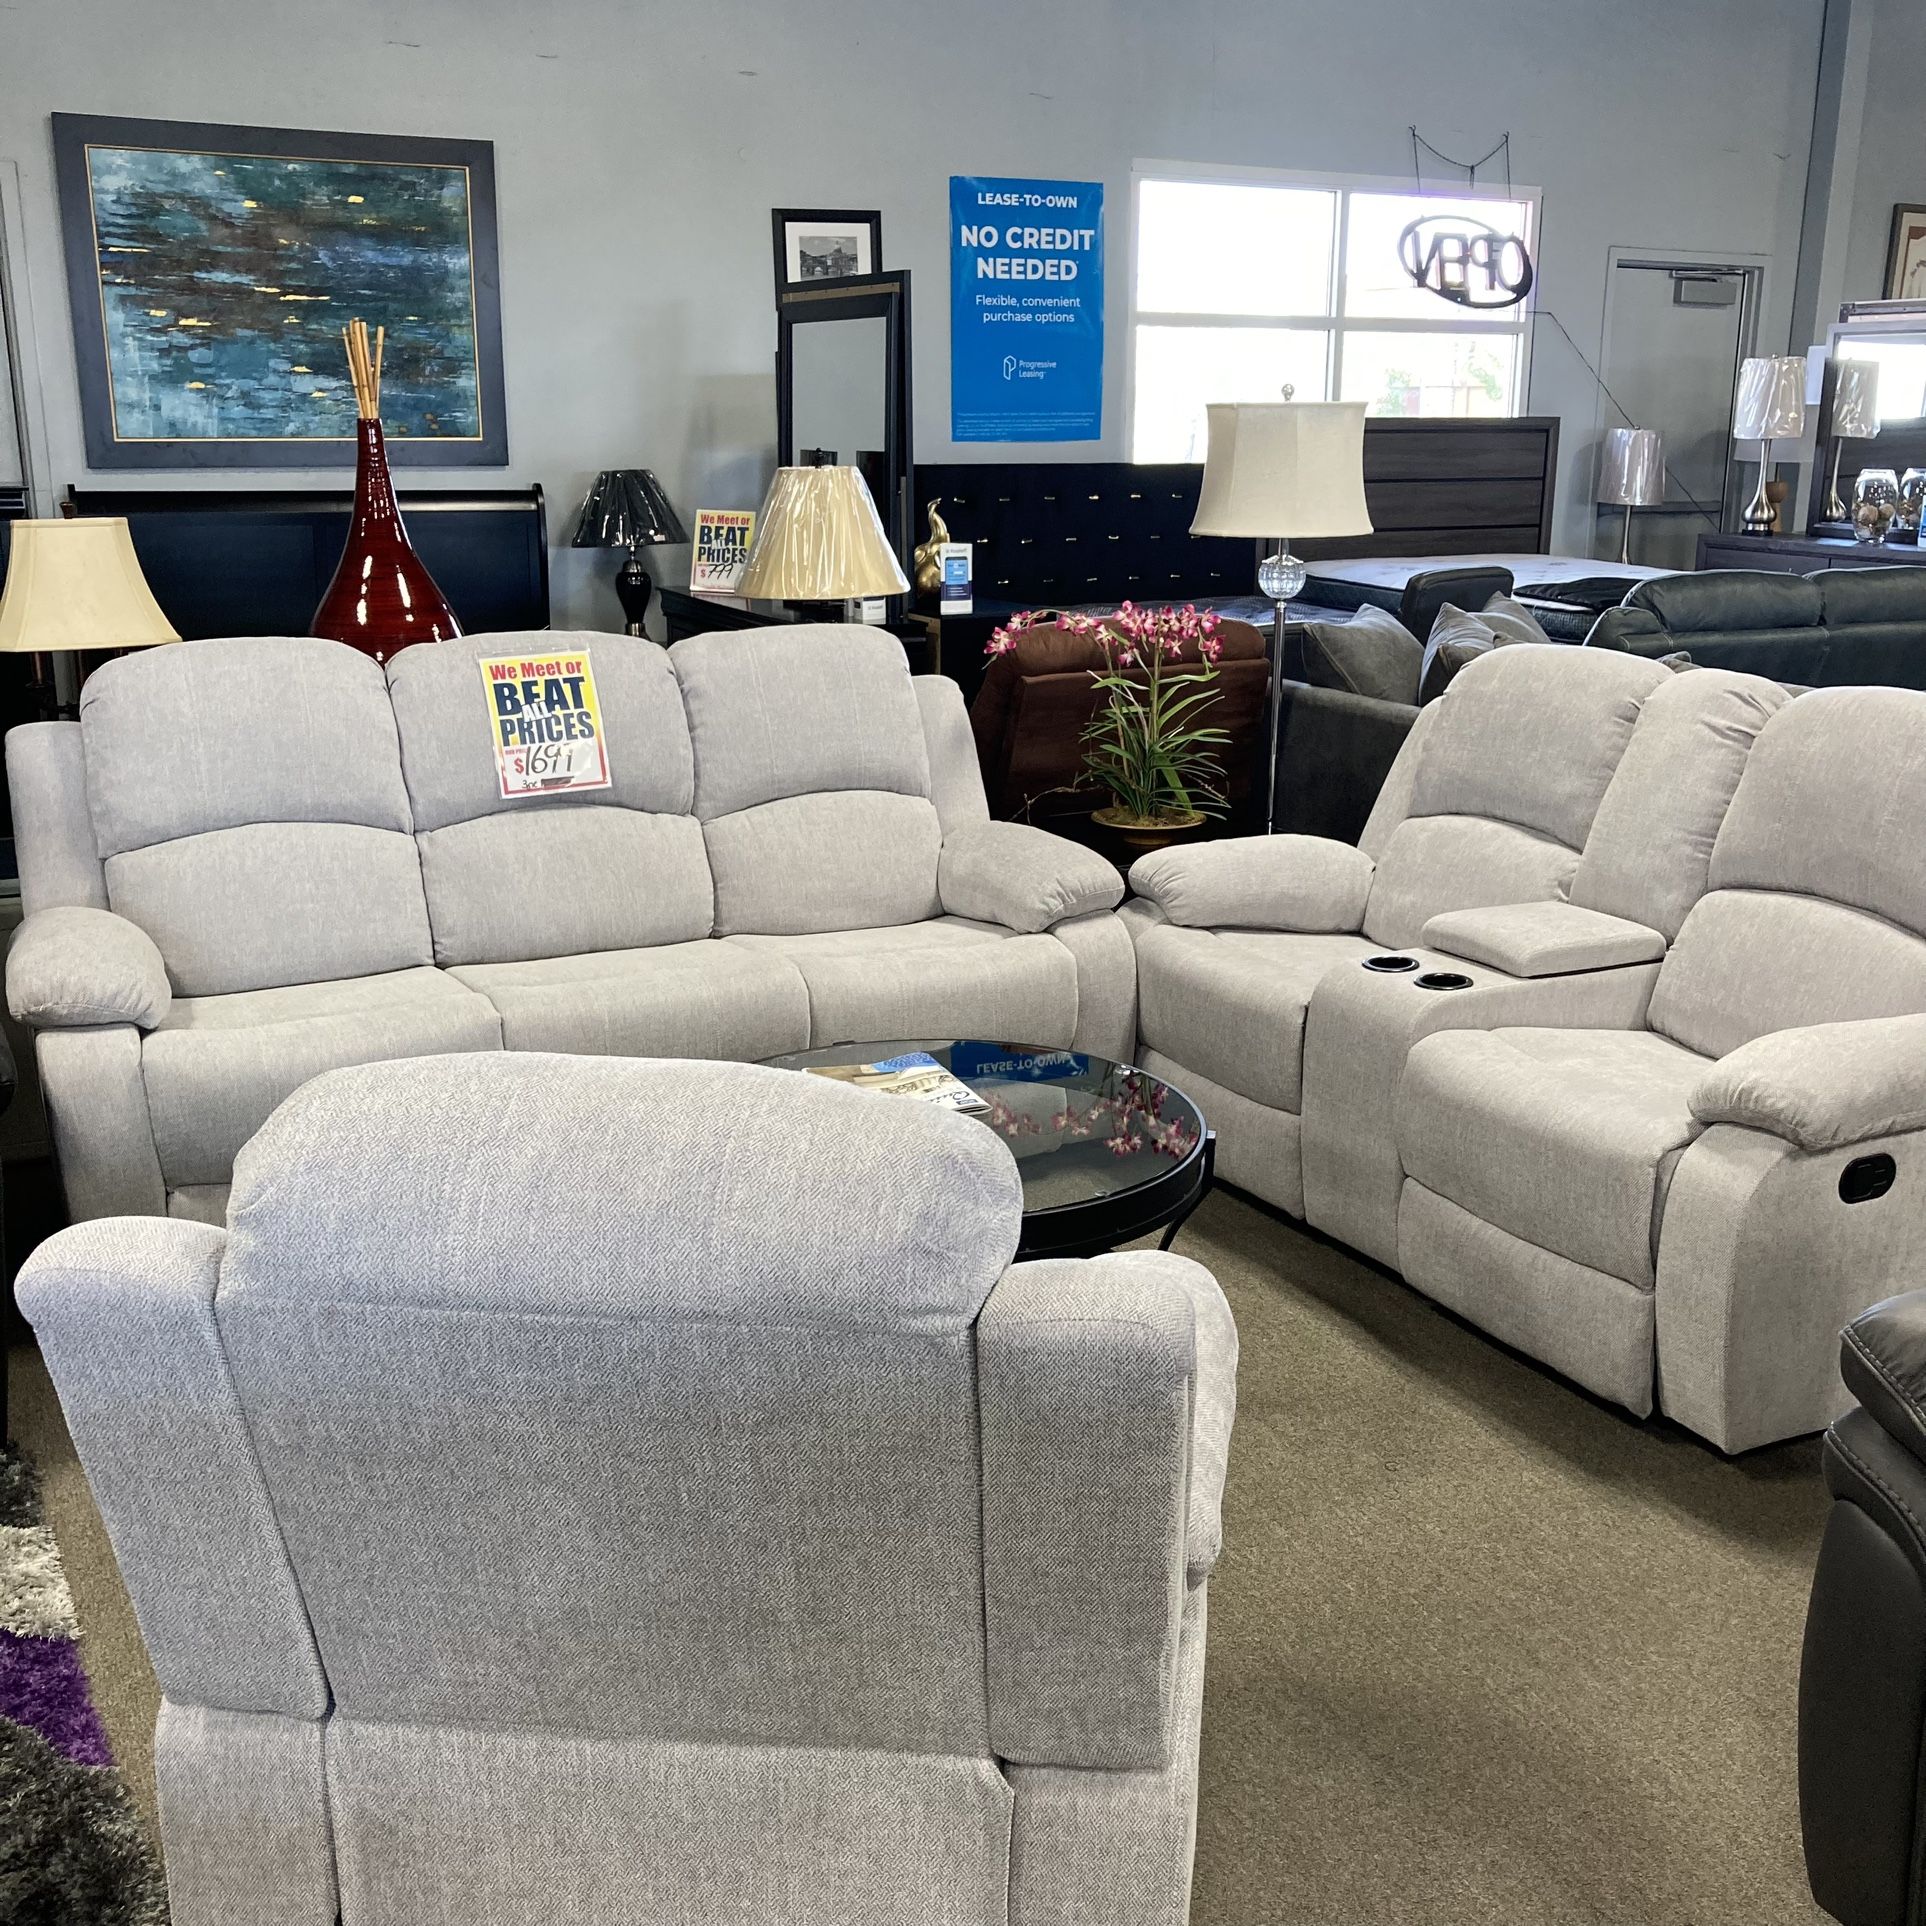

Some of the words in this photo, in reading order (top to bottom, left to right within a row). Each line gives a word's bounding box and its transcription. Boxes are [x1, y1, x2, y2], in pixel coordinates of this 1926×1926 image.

[977, 192, 1078, 209] LEASE-TO-OWN
[960, 224, 999, 249] NO
[1005, 226, 1095, 251] CREDIT
[976, 257, 1078, 281] NEEDED
[975, 294, 1020, 308] Flexible,
[1021, 296, 1081, 308] convenient
[983, 311, 1033, 324] purchase
[1034, 312, 1075, 324] options
[1018, 360, 1057, 370] Progressive
[1018, 370, 1044, 380] Leasing
[700, 514, 715, 524] We
[717, 515, 739, 525] Meet
[740, 517, 751, 525] or
[698, 525, 750, 547] BEAT
[697, 546, 748, 564] PRICES
[488, 664, 518, 681] We
[520, 661, 562, 678] Meet
[565, 661, 582, 674] or
[492, 676, 586, 717] BEAT
[521, 700, 553, 723] ALL
[499, 711, 596, 748] PRICES
